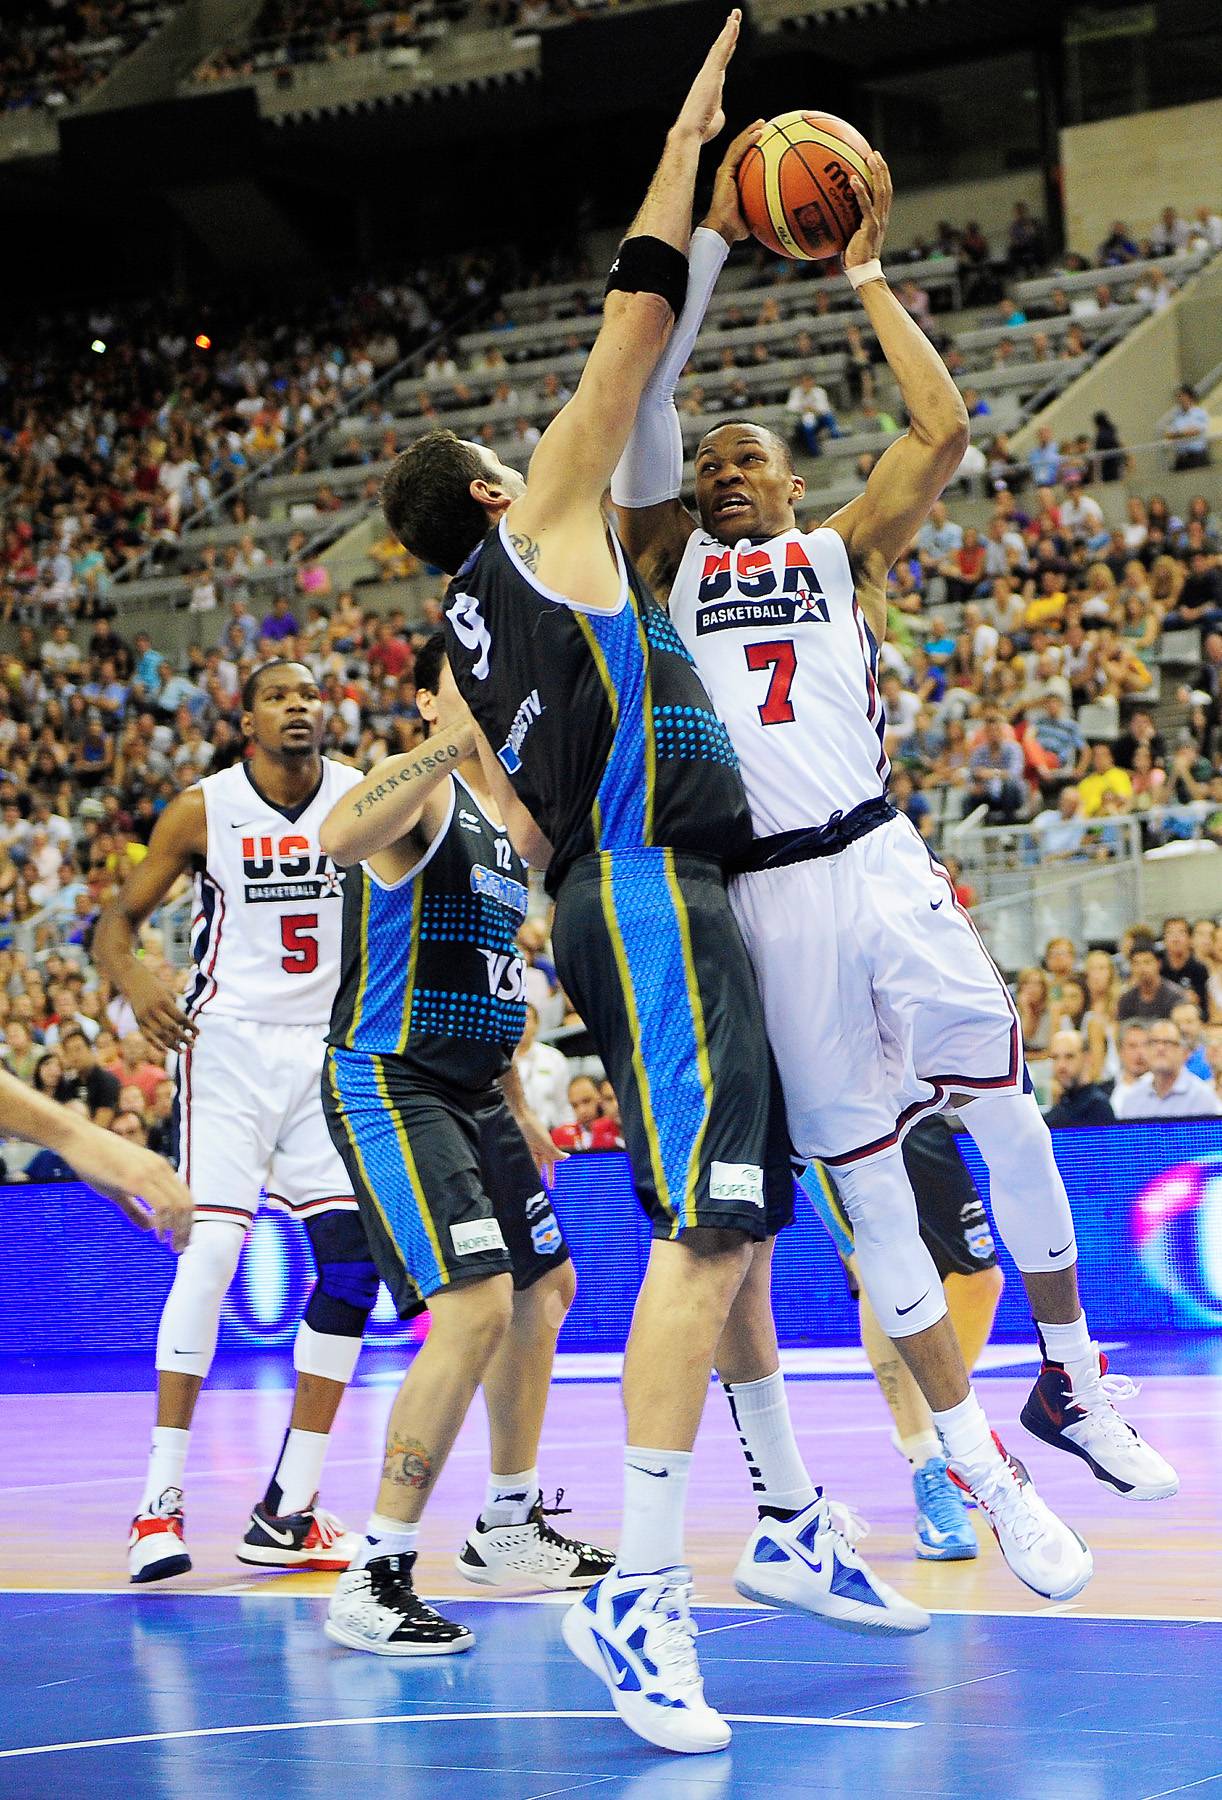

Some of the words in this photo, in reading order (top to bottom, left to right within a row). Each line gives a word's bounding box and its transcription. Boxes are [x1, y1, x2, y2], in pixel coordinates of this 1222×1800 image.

[698, 542, 823, 603] USA
[702, 604, 786, 627] BASKETBALL
[445, 592, 491, 680] 9
[743, 639, 797, 726] 7
[494, 838, 512, 871] 12
[248, 884, 317, 899] BASKETBALL
[280, 914, 318, 974] 5
[712, 1183, 748, 1197] HOPE
[457, 1234, 489, 1251] HOPE
